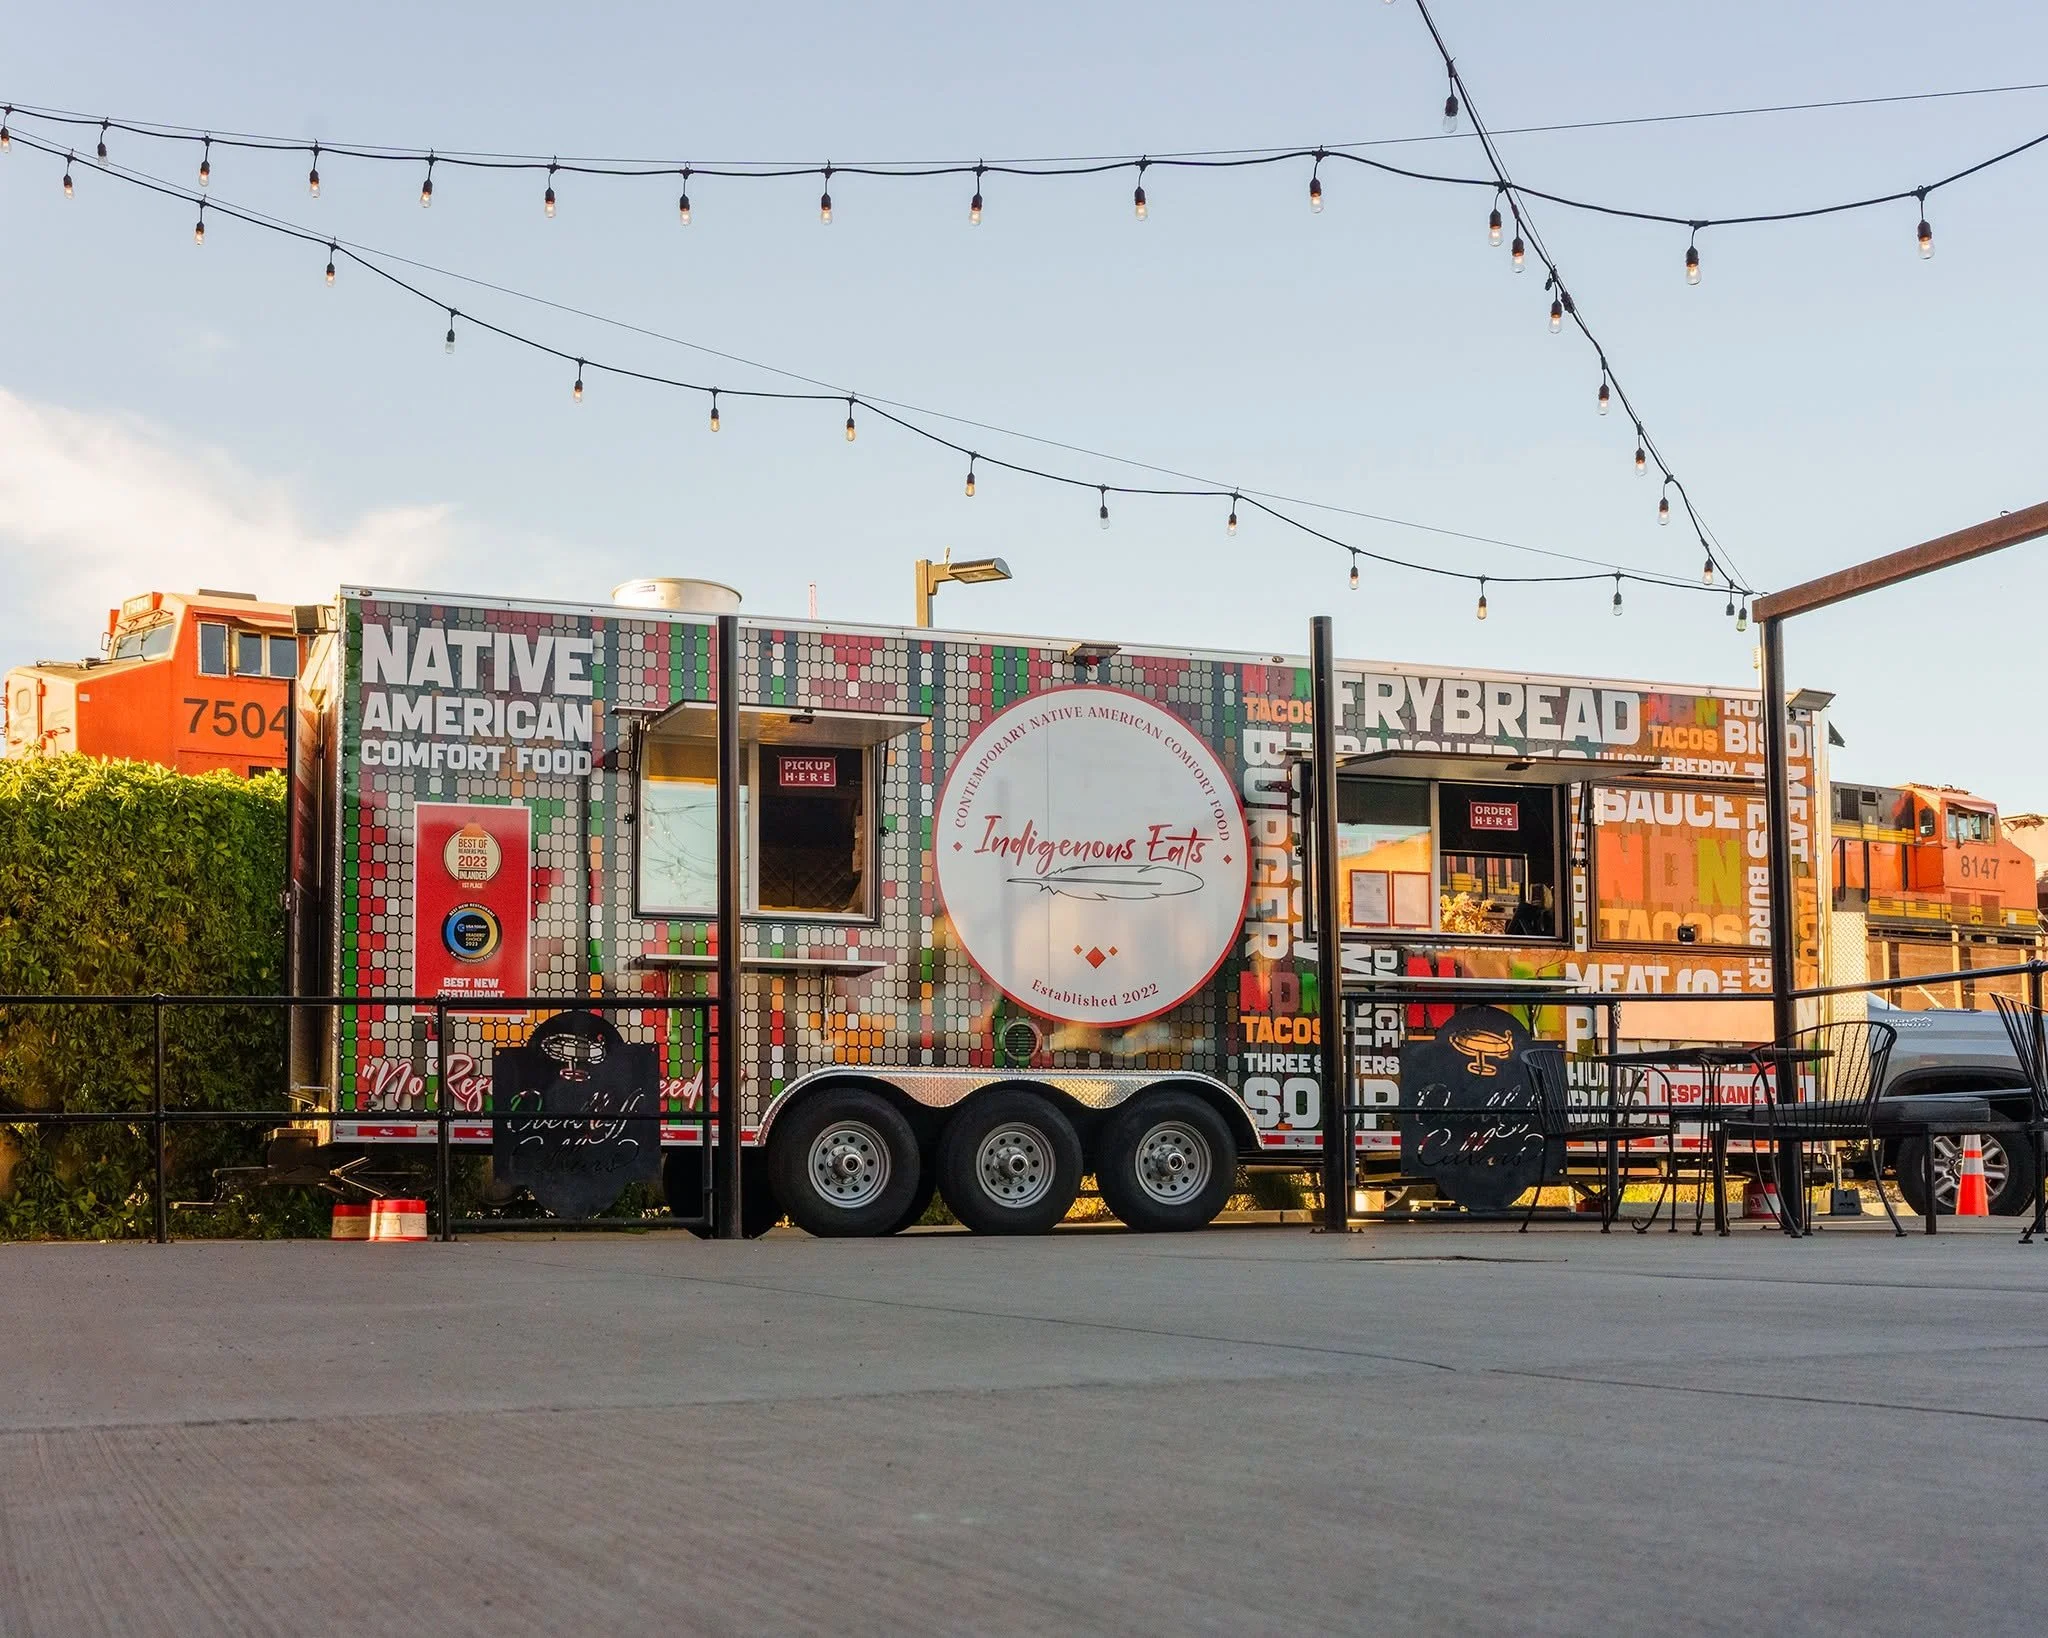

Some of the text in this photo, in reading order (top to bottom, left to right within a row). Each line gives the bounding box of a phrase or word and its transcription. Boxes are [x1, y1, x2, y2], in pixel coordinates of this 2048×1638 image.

[362, 623, 593, 696] NATIVE
[183, 698, 288, 740] 7504
[361, 692, 593, 743] AMERICAN
[1242, 697, 1312, 724] TACOS
[1334, 670, 1641, 745] FRYBREAD
[1648, 693, 1717, 727] NDN
[1648, 724, 1718, 753] TACOS
[361, 740, 592, 776] COMFORT FOOD
[955, 706, 1230, 841] CONTEMPORARY NATIVE AMERICAN COMFORT FOOD
[1475, 806, 1512, 816] ORDER
[1601, 788, 1740, 829] SAUCE
[458, 838, 488, 849] BEST OF
[974, 814, 1214, 875] Indigenous Eats
[1242, 729, 1289, 960] BURGER
[458, 855, 487, 867] 2023
[458, 870, 487, 880] INLANDER
[1598, 832, 1742, 907] NDN
[1961, 855, 1999, 880] 8147
[443, 977, 499, 989] BEST NEW
[1032, 979, 1159, 1007] Established 2022
[1240, 971, 1320, 1013] NDN
[1565, 963, 1669, 994] MEAT
[1243, 1052, 1311, 1073] THREE
